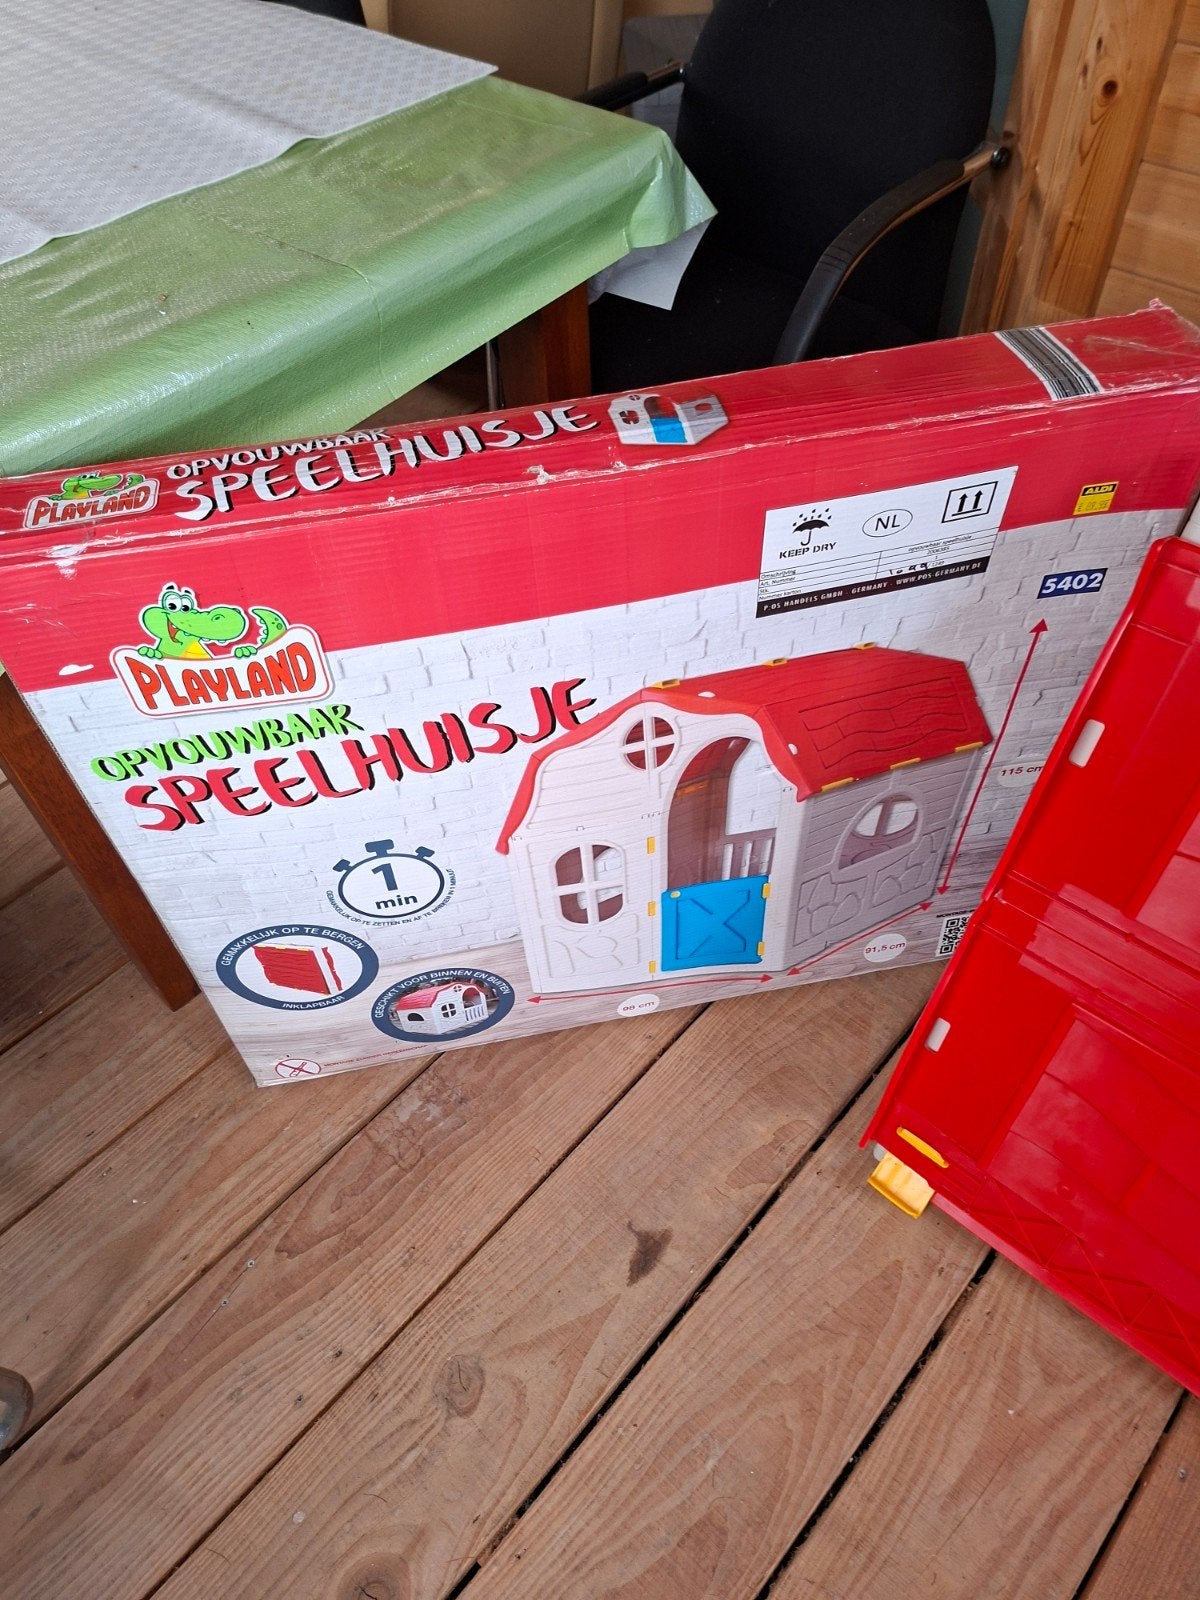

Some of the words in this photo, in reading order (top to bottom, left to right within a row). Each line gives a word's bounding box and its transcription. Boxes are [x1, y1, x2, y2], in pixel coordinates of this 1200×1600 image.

[167, 427, 392, 479] OPVOUWBAAR
[175, 405, 599, 520] SPEELHUISJE
[1085, 485, 1114, 495] ALDI
[32, 484, 150, 526] PLAYLAND
[874, 514, 901, 532] NL
[779, 547, 810, 560] KEEP
[812, 542, 837, 554] DRY
[761, 569, 797, 580] Omschrijving
[1041, 572, 1104, 594] 5402
[783, 595, 818, 608] HANDELS
[820, 590, 843, 600] GMBH
[851, 582, 889, 594] GERMANY
[127, 641, 317, 710] PLAYLAND
[90, 703, 364, 782] OPVOUWBAAR
[124, 677, 598, 831] SPEELHUISJE
[1001, 766, 1023, 776] 115
[371, 862, 398, 892] 1
[375, 894, 418, 910] min
[220, 928, 279, 966] GEMAKKELIJK
[281, 926, 300, 934] OP
[303, 926, 319, 935] TE
[321, 929, 366, 950] BERGEN
[865, 944, 888, 954] 91,5
[889, 942, 906, 950] cm
[282, 995, 345, 1010] INKLAPBAAR
[375, 988, 400, 1018] GESCHIKT
[398, 974, 429, 989] VOOR
[430, 969, 473, 979] BINNEN
[473, 971, 488, 980] EN
[487, 976, 511, 995] BUITEN
